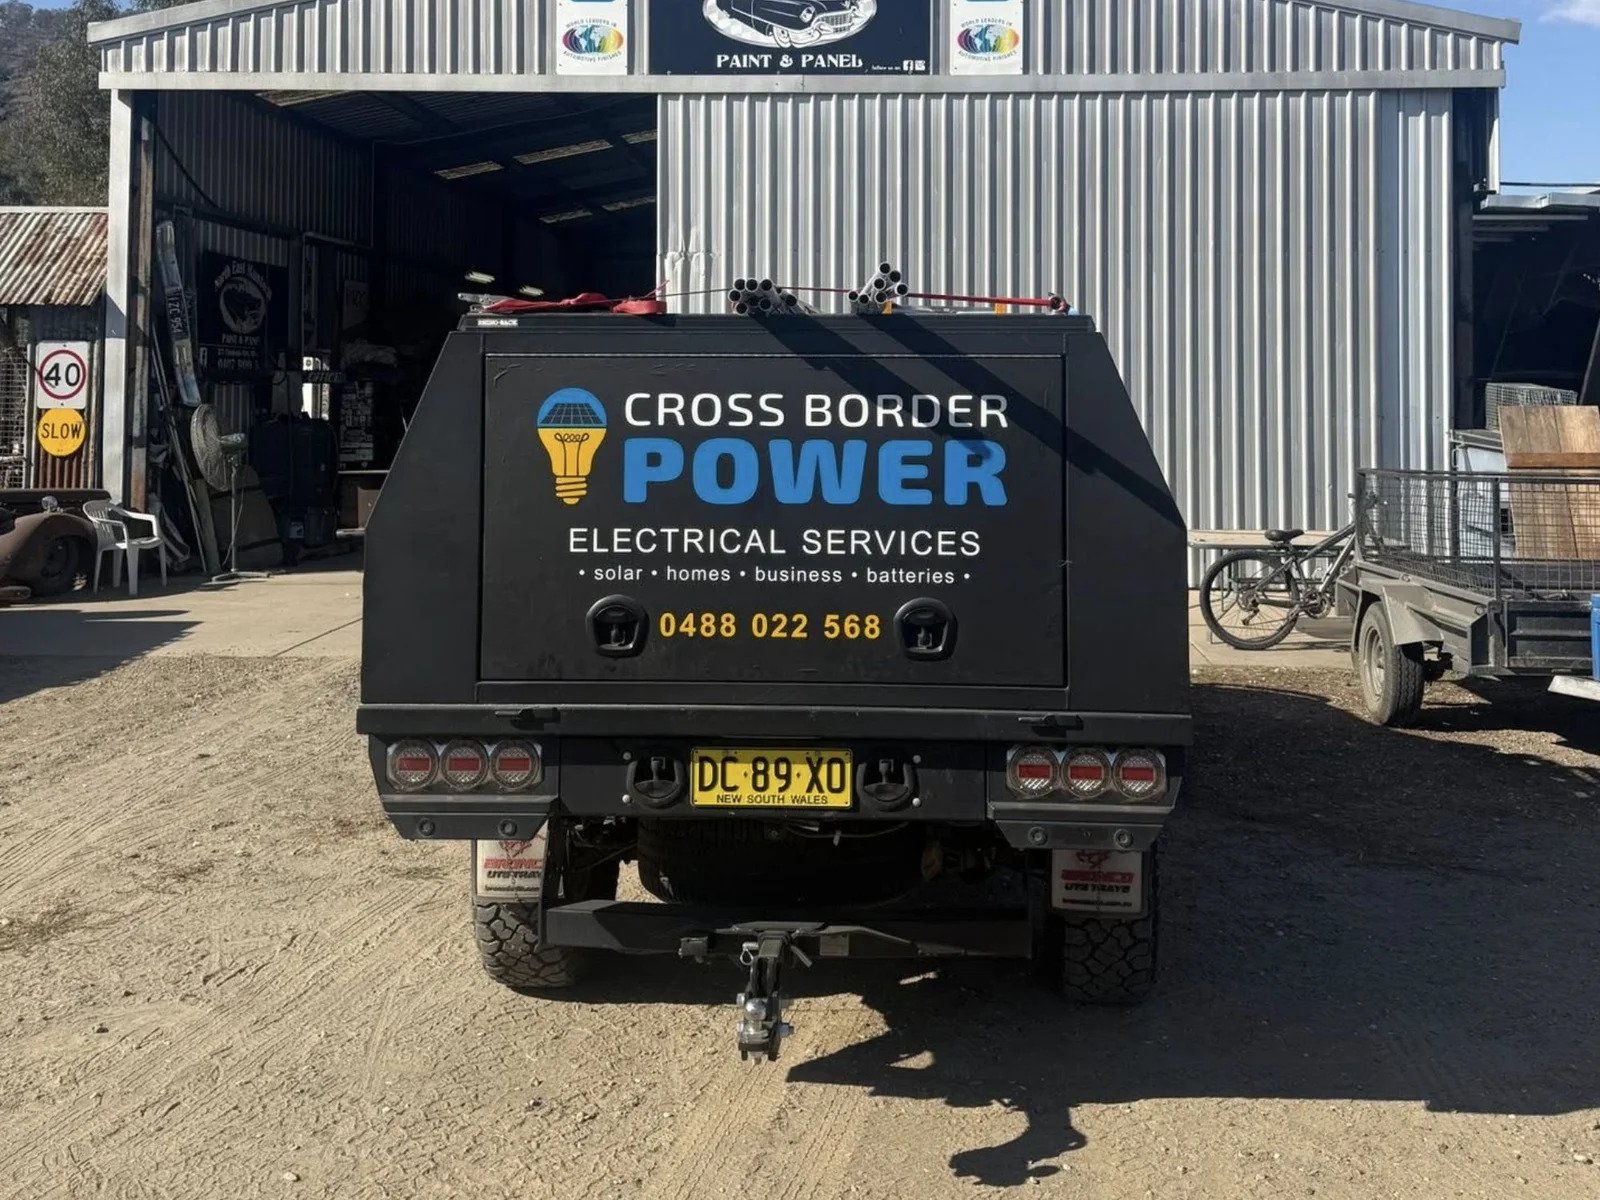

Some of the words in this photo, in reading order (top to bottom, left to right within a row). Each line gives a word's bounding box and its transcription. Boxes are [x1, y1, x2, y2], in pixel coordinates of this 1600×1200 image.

[717, 54, 772, 68] PAINT
[779, 54, 794, 68] &
[801, 54, 863, 68] PANEL
[44, 363, 81, 387] 40
[624, 392, 785, 428] CROSS
[805, 394, 1008, 429] BORDER
[41, 423, 82, 439] SLOW
[623, 437, 1008, 506] POWER
[569, 527, 786, 554] ELECTRICAL
[802, 529, 981, 556] SERVICES
[594, 564, 642, 581] solar
[667, 565, 731, 582] homes
[755, 566, 842, 583] business
[867, 567, 955, 584] batteries
[659, 612, 737, 638] 0488
[751, 612, 808, 638] 022
[823, 613, 881, 640] 568
[717, 794, 741, 803] NEW
[747, 794, 785, 804] SOUTH
[791, 795, 828, 805] WALES
